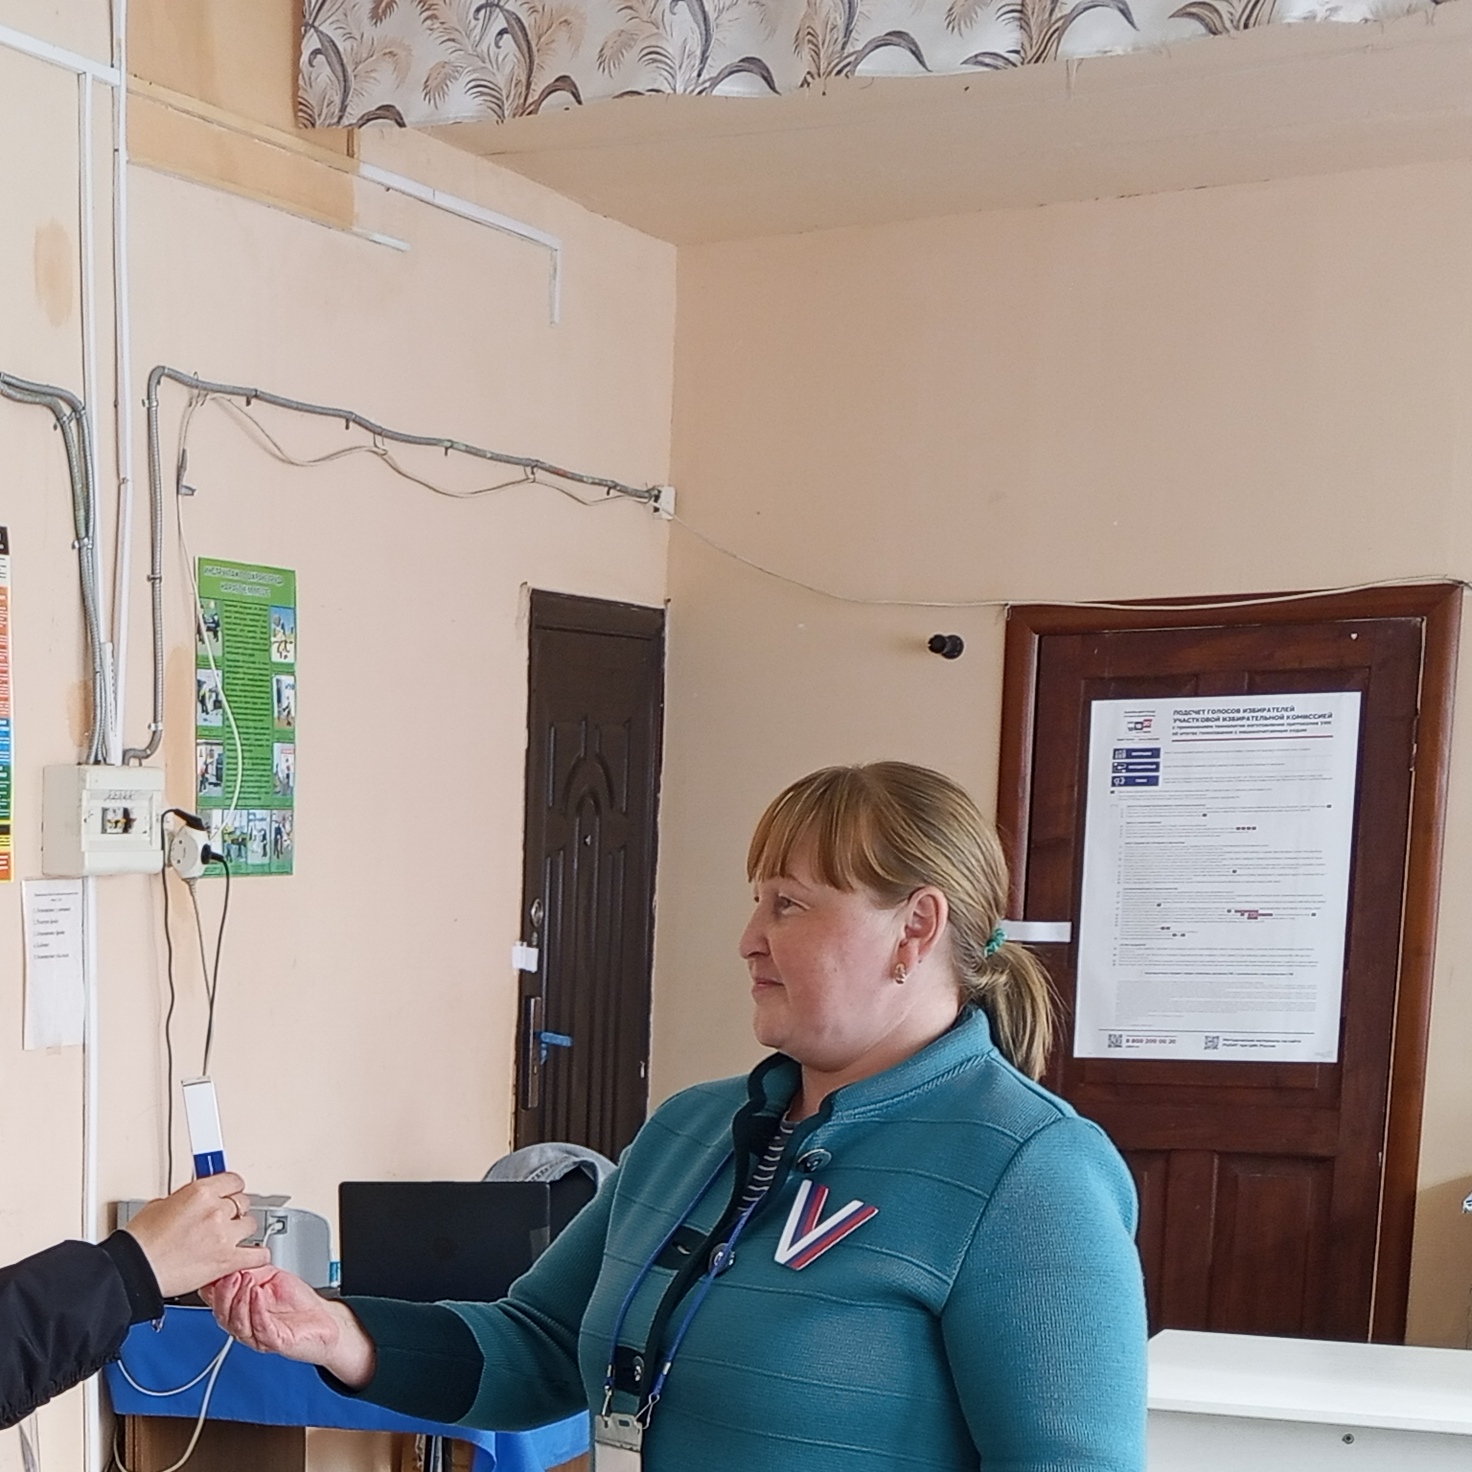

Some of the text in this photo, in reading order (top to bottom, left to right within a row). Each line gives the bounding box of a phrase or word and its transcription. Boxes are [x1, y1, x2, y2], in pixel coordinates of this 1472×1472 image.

[1242, 705, 1295, 713] ИЗБИРАТЕЛЕЙ
[1222, 713, 1285, 722] ИЗБИРАТЕЛЬНОЙ
[1286, 711, 1333, 720] КОМИССИЕЙ
